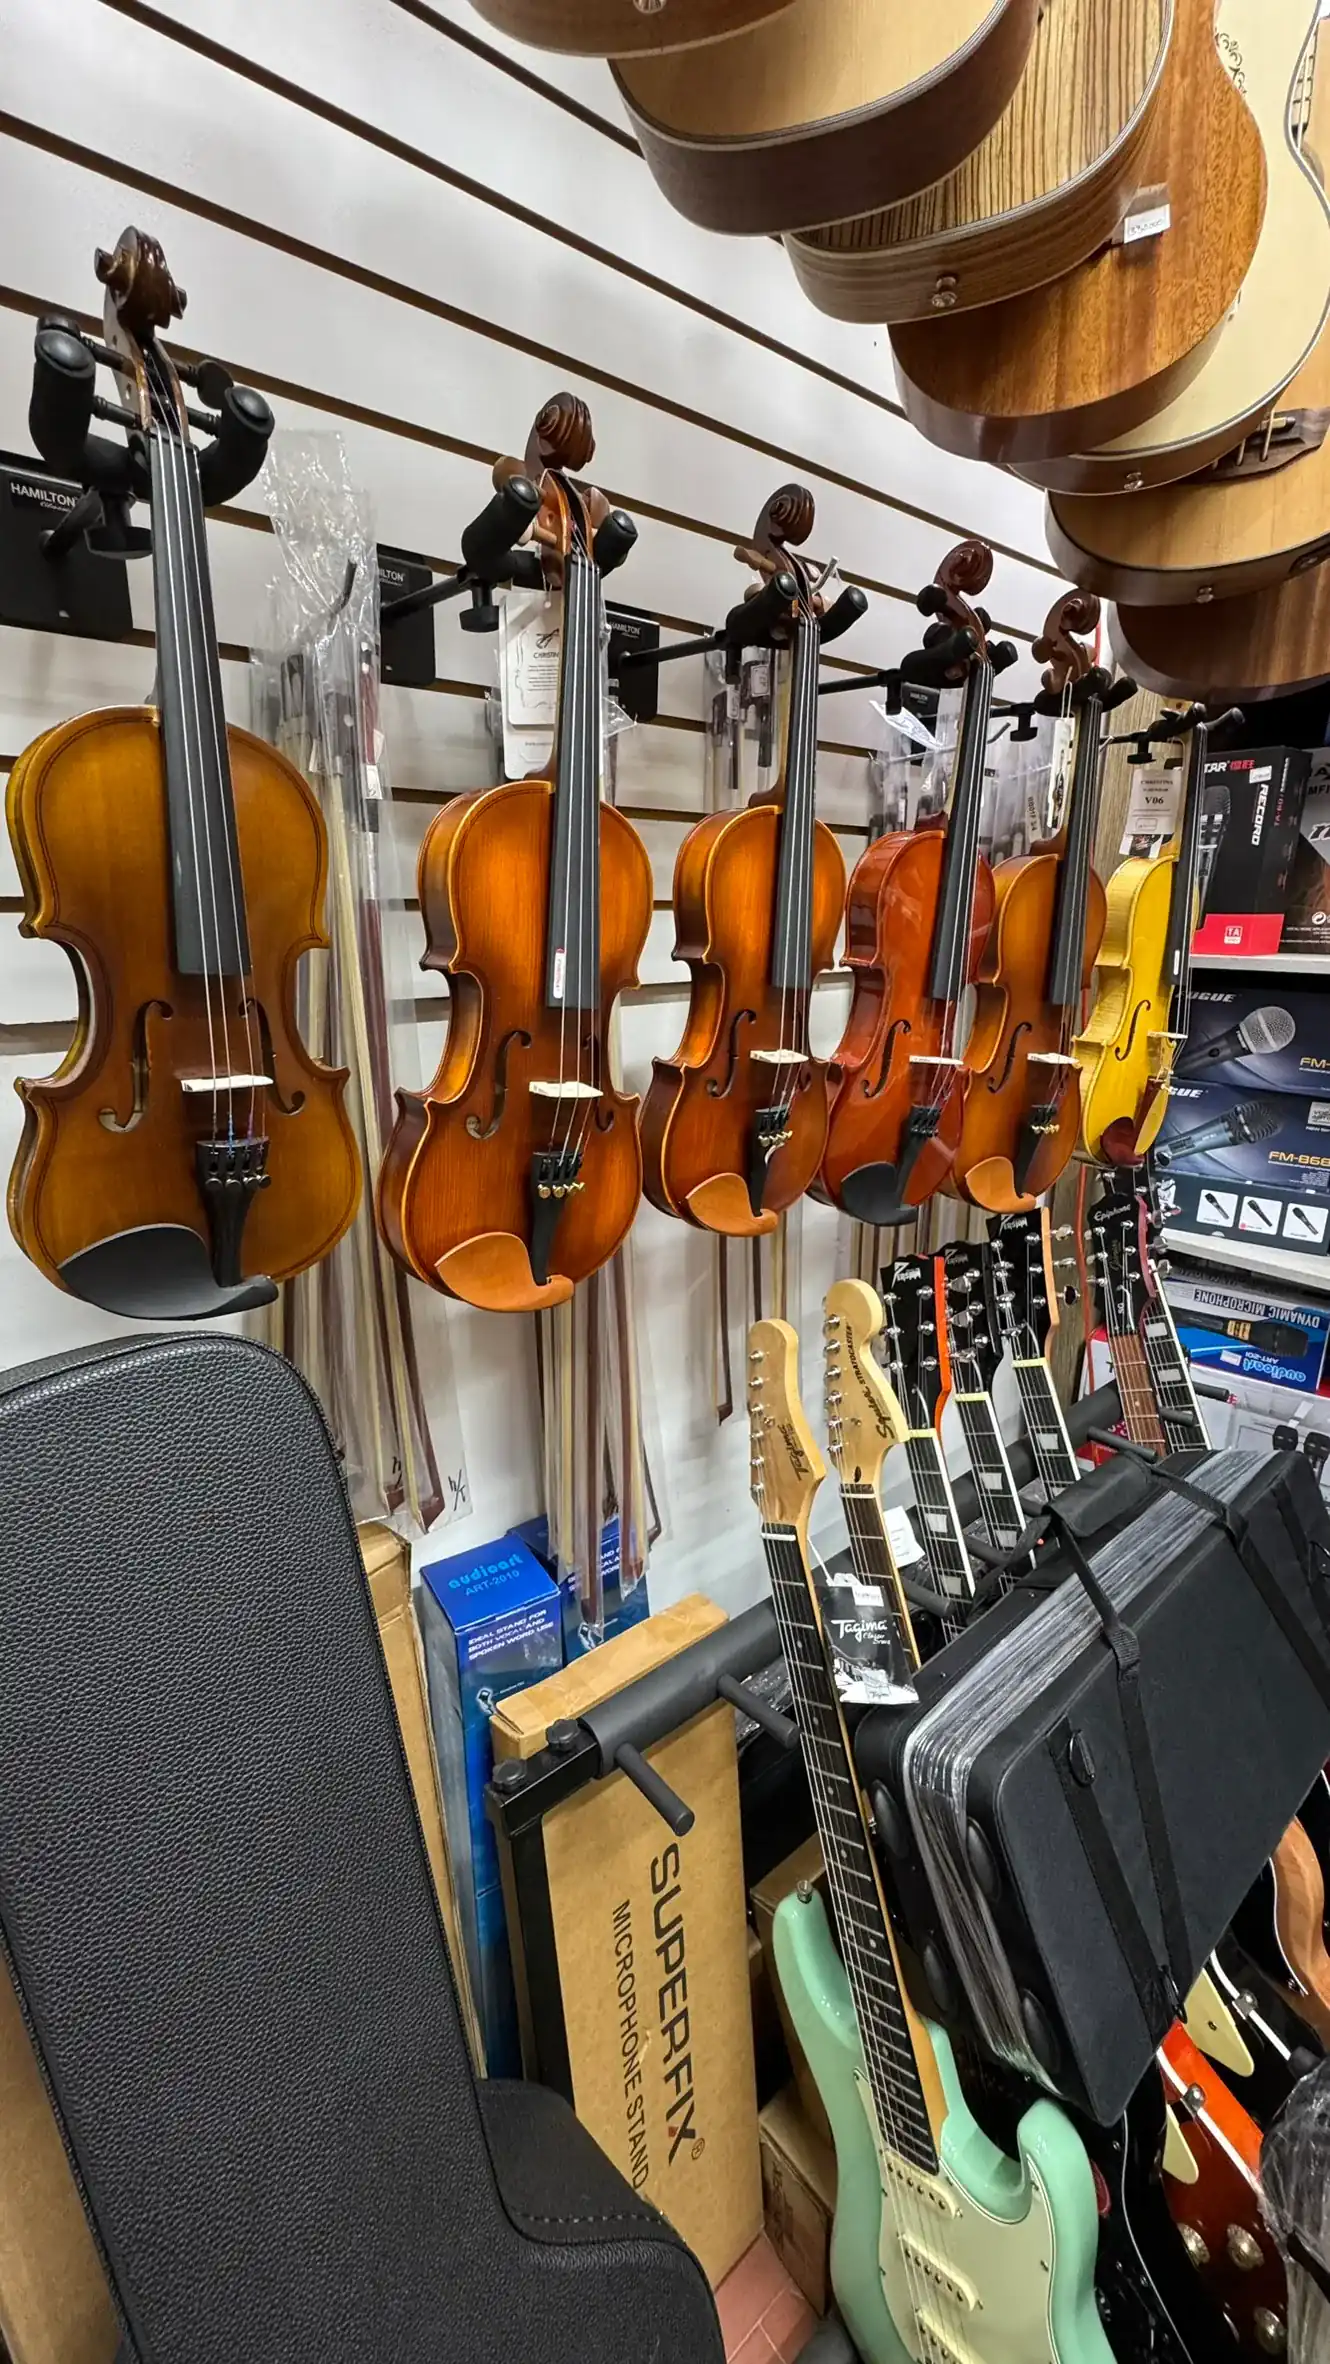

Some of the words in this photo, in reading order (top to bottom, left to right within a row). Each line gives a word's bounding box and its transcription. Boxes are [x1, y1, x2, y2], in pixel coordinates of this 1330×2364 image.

[10, 482, 76, 508] HAMILTON
[533, 651, 560, 659] CHRISTIN
[1145, 796, 1164, 805] V06
[1251, 783, 1269, 846] RECORD
[1168, 1086, 1203, 1098] GUE
[1269, 1151, 1330, 1168] FM-868
[1094, 1203, 1131, 1222] Epiphone
[1194, 1288, 1265, 1316] MICROPHONE
[1268, 1306, 1321, 1328] DYNAMIC
[1242, 1357, 1307, 1383] audioart
[448, 1553, 524, 1589] audioart
[464, 1570, 521, 1597] ART-2010
[468, 1631, 495, 1645] IDEAL
[496, 1618, 527, 1634] STAND
[529, 1609, 547, 1621] FOR
[468, 1639, 493, 1653] BOTH
[495, 1627, 522, 1641] VOCAL
[526, 1618, 545, 1629] AND
[829, 1618, 888, 1643] Tagima
[468, 1641, 505, 1661] SPOKEN
[506, 1629, 535, 1645] WORD
[537, 1621, 554, 1632] USE
[612, 1899, 643, 2097] MICROPHONE
[649, 1841, 697, 2167] SUPERFIX
[627, 2097, 650, 2191] STAND
